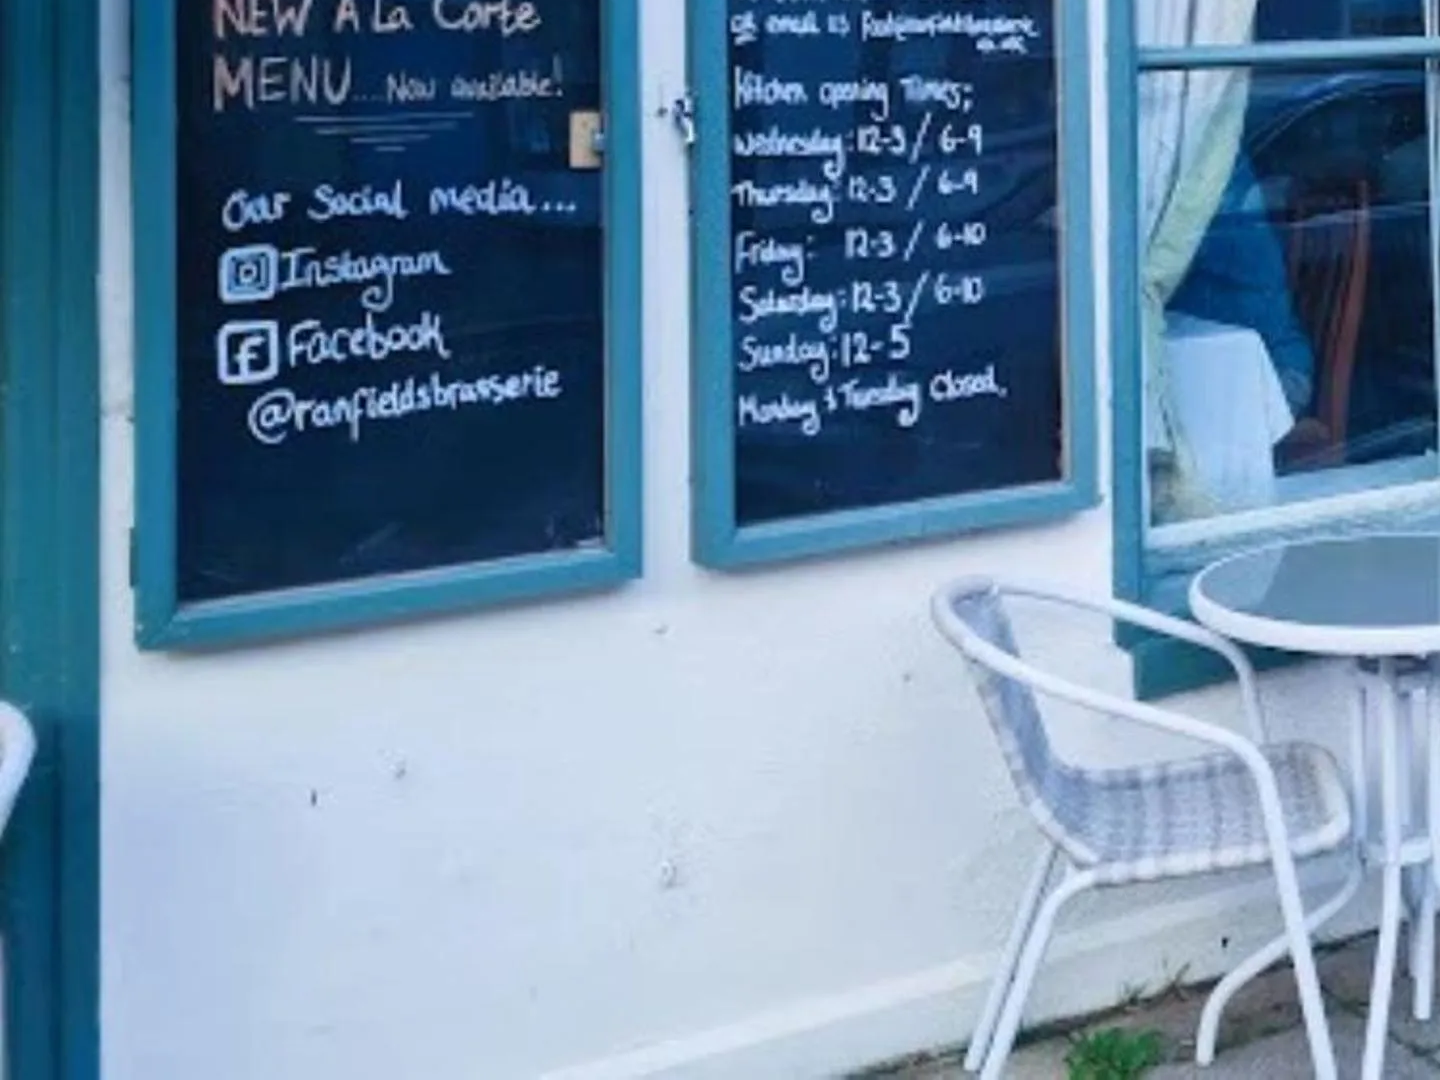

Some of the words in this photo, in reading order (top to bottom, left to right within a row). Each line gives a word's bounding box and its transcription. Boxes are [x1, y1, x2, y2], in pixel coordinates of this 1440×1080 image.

[734, 65, 808, 109] Kitchen
[818, 74, 891, 122] opening
[855, 123, 907, 155] 12-3
[937, 124, 983, 156] 6-9
[221, 186, 292, 231] Our
[307, 179, 408, 220] Social
[847, 176, 897, 203] 12-3
[936, 169, 979, 196] 6-9
[844, 229, 896, 260] 12-3
[934, 222, 987, 250] 6-10
[277, 245, 453, 312] Instagram
[851, 280, 902, 314] 12-3
[932, 276, 985, 305] 6-10
[288, 312, 452, 368] Facebook
[247, 364, 563, 444] @ranfieldsbrasserie
[737, 393, 821, 436] Monday
[838, 375, 921, 427] Tuesday
